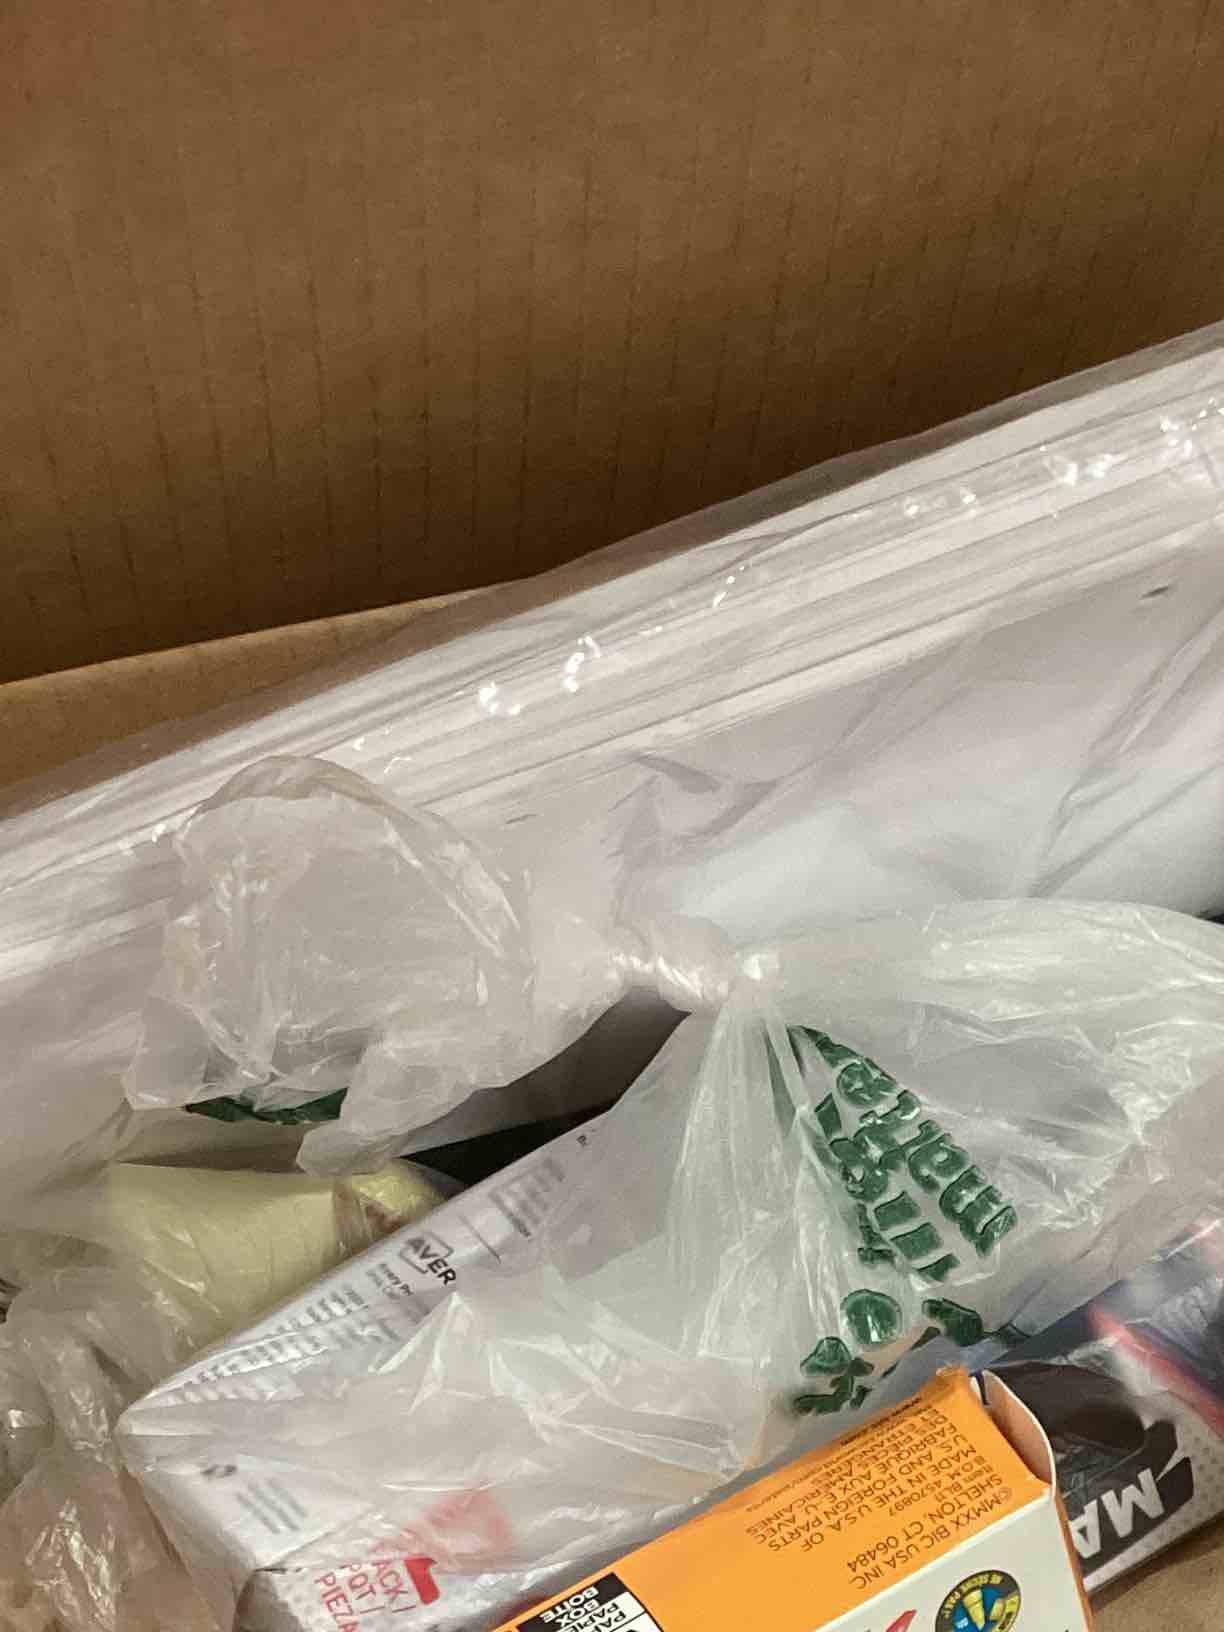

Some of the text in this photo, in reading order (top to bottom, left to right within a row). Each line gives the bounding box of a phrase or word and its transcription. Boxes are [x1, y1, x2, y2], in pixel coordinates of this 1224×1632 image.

[405, 1236, 457, 1286] AVER
[896, 1448, 934, 1477] AND
[925, 1441, 976, 1478] MADE
[906, 1470, 926, 1488] IN
[822, 1469, 897, 1521] FOREIGN
[872, 1482, 905, 1508] THE
[766, 1513, 823, 1554] PARTS
[797, 1529, 825, 1553] OF
[899, 1518, 925, 1541] CT
[918, 1523, 951, 1550] BIC
[845, 1533, 900, 1573] 06484
[884, 1541, 921, 1570] USA
[554, 1596, 600, 1629] BOX
